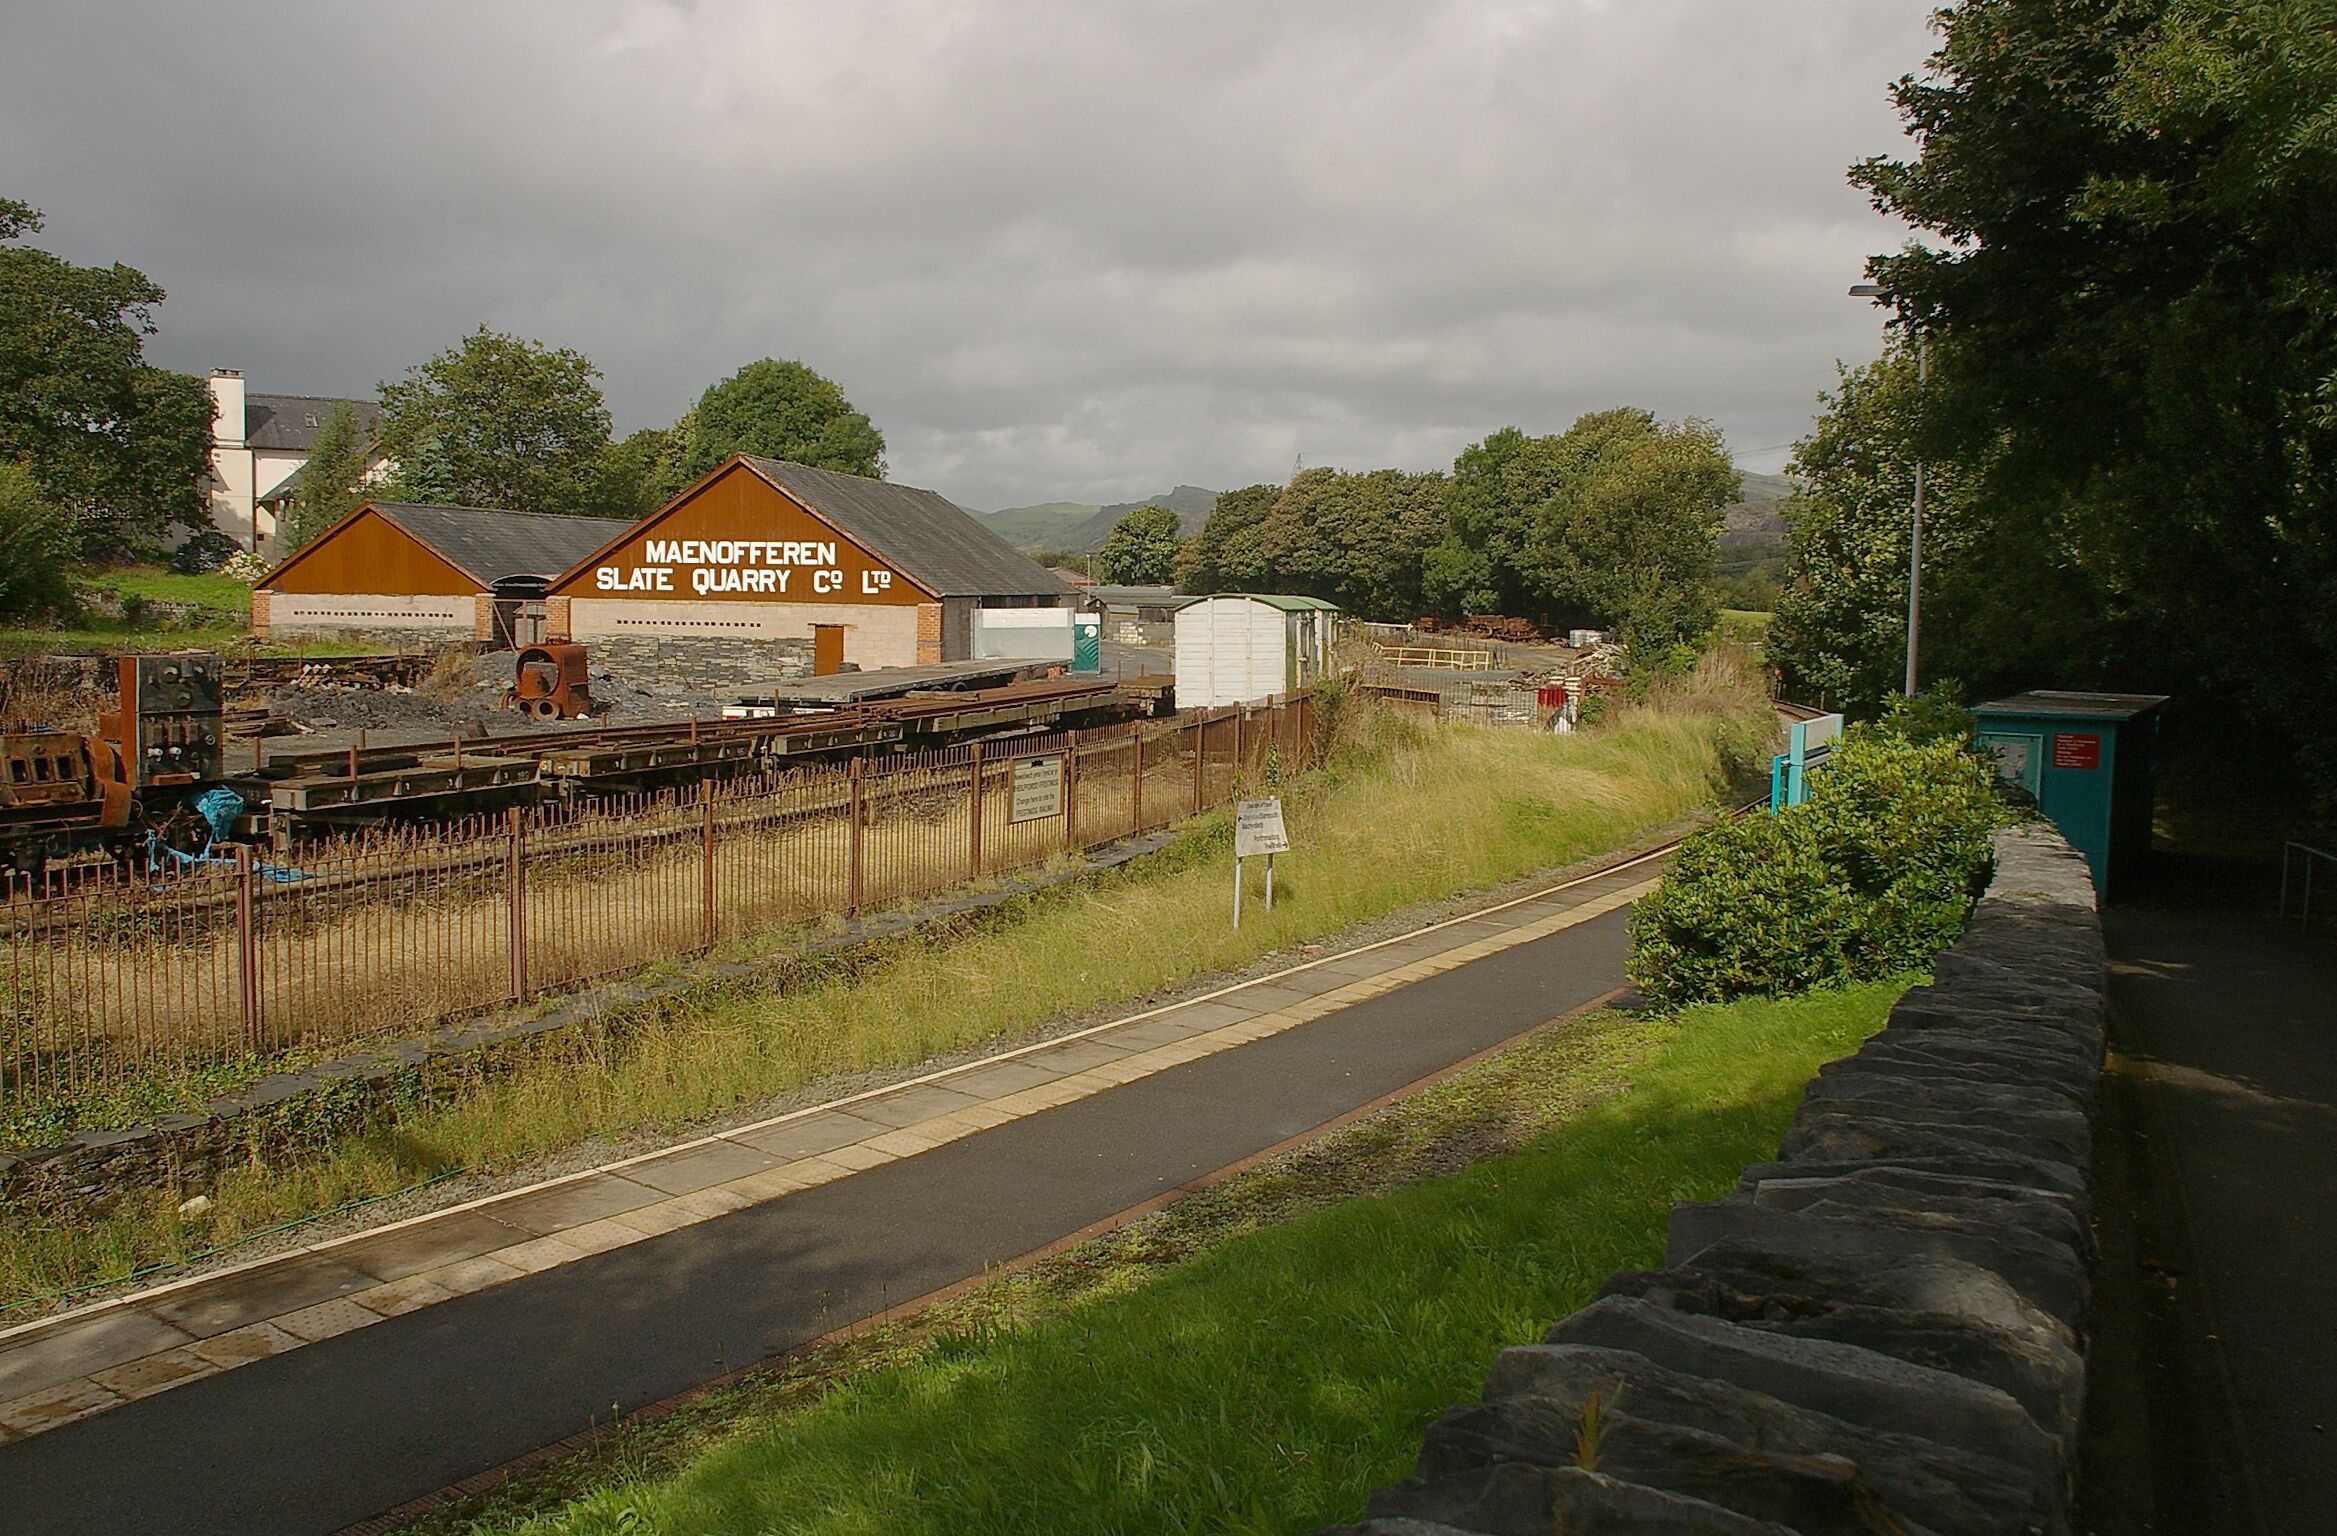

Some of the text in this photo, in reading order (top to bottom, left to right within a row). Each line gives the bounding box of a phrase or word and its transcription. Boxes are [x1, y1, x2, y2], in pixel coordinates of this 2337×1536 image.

[645, 540, 836, 566] MAENOFFEREN
[596, 567, 674, 592] SLATE
[692, 568, 791, 596] QUARRY
